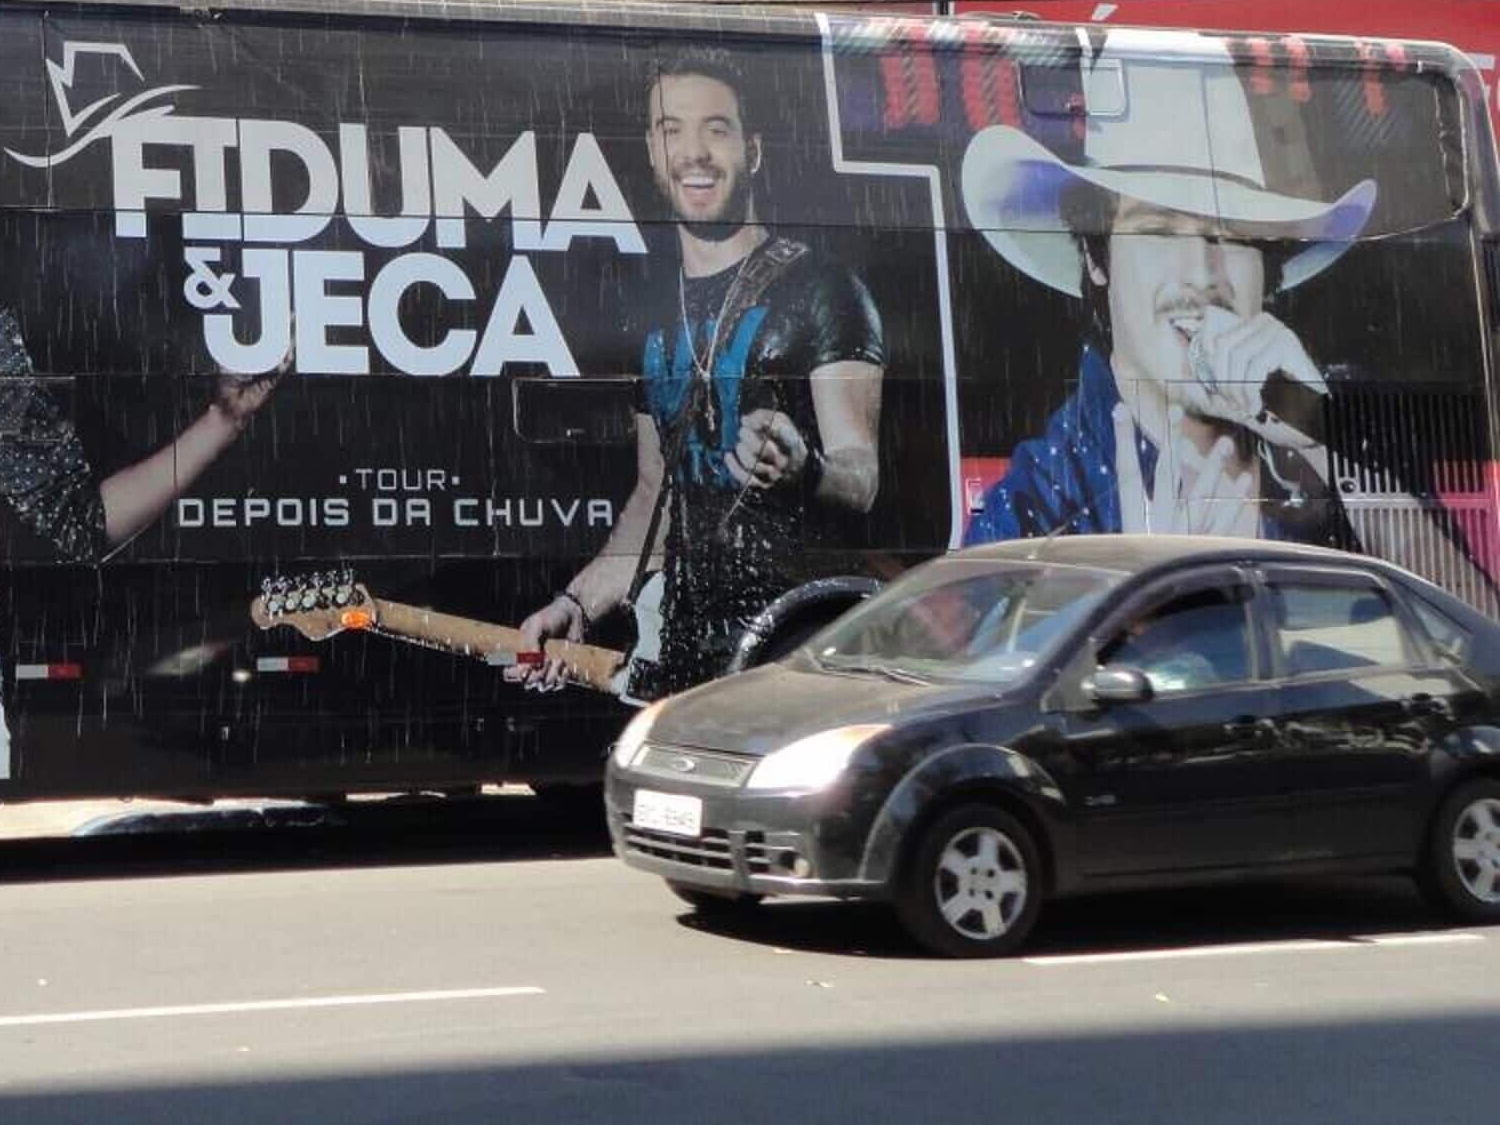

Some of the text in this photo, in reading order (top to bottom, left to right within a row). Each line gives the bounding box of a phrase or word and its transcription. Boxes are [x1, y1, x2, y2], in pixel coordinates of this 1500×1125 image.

[110, 115, 648, 254] FIDUMA
[203, 248, 581, 376] JECA
[178, 498, 614, 527] DEPOIS DA CHUVA
